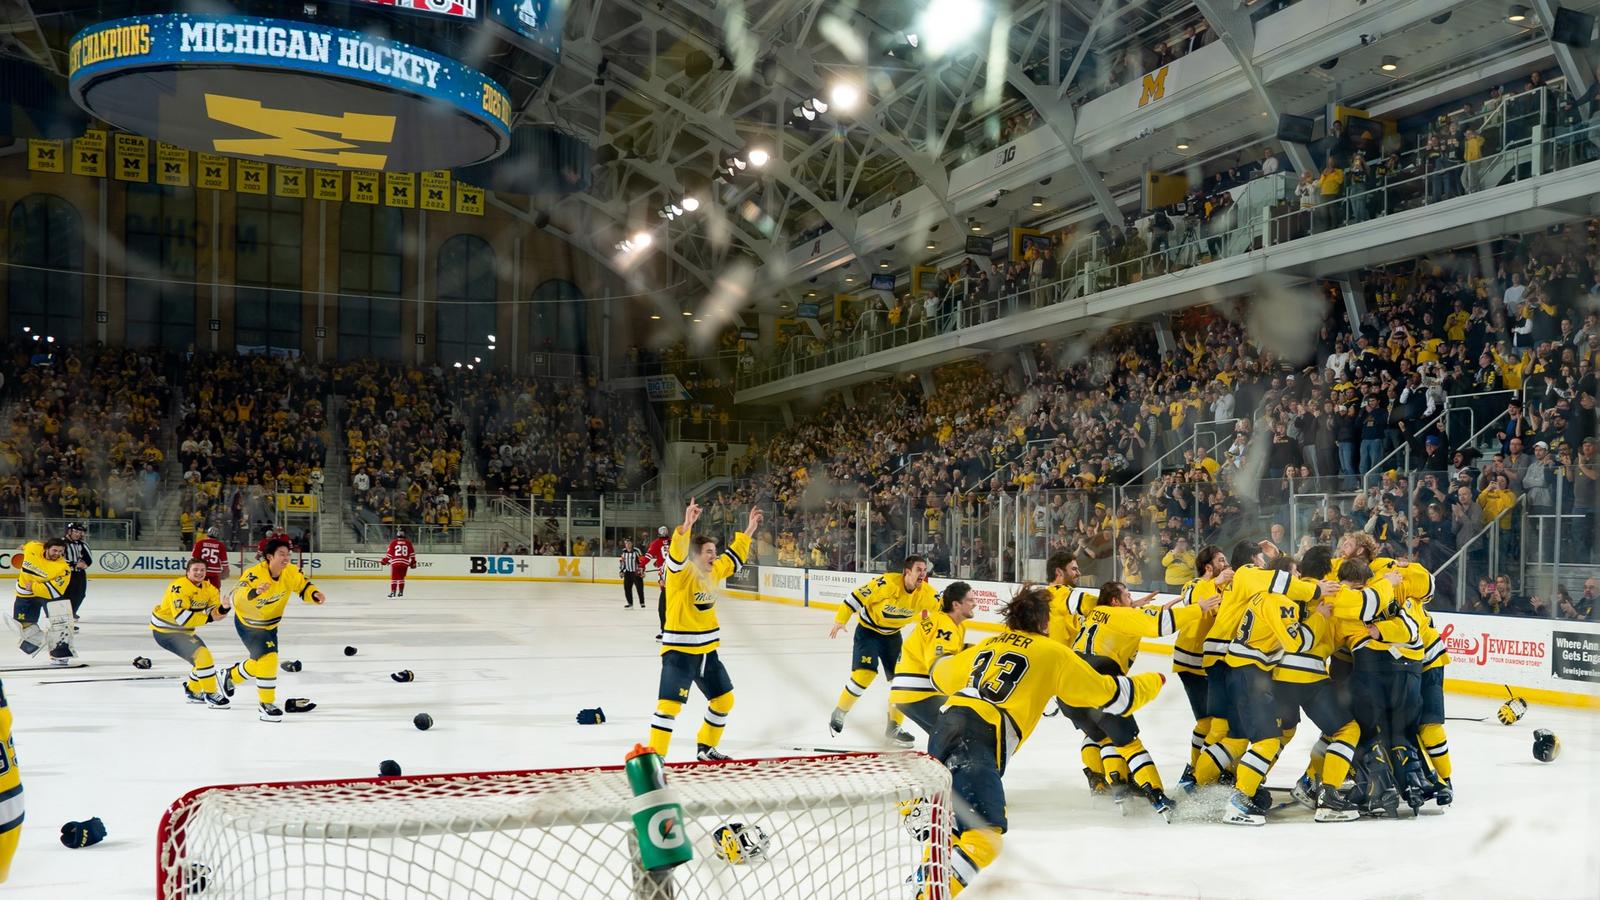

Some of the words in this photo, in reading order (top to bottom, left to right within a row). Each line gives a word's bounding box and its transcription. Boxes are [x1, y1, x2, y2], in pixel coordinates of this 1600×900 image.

[82, 24, 150, 66] CHAMPIONS
[180, 22, 331, 63] MICHIGAN
[337, 37, 441, 89] HOCKEY
[1138, 66, 1169, 108] M
[80, 152, 98, 164] M
[123, 158, 141, 169] M
[164, 162, 182, 174] M
[205, 167, 222, 178] M
[244, 171, 260, 182] M
[321, 178, 337, 189] M
[357, 182, 373, 193] M
[392, 186, 408, 197] M
[428, 189, 443, 200] M
[425, 201, 446, 209] 2022
[463, 194, 478, 204] M
[290, 495, 304, 505] M
[201, 548, 220, 564] 25
[394, 545, 409, 557] 28
[132, 556, 188, 570] Allstat
[347, 559, 380, 569] Hilton
[558, 558, 581, 577] M
[876, 576, 887, 588] M
[171, 584, 182, 594] M
[1280, 606, 1295, 619] M
[936, 628, 953, 641] M
[1476, 633, 1546, 666] JEWELERS
[1556, 637, 1581, 649] Where
[1582, 639, 1599, 651] Ann
[861, 655, 872, 664] M
[1562, 650, 1581, 662] Gets
[647, 809, 687, 849] G
